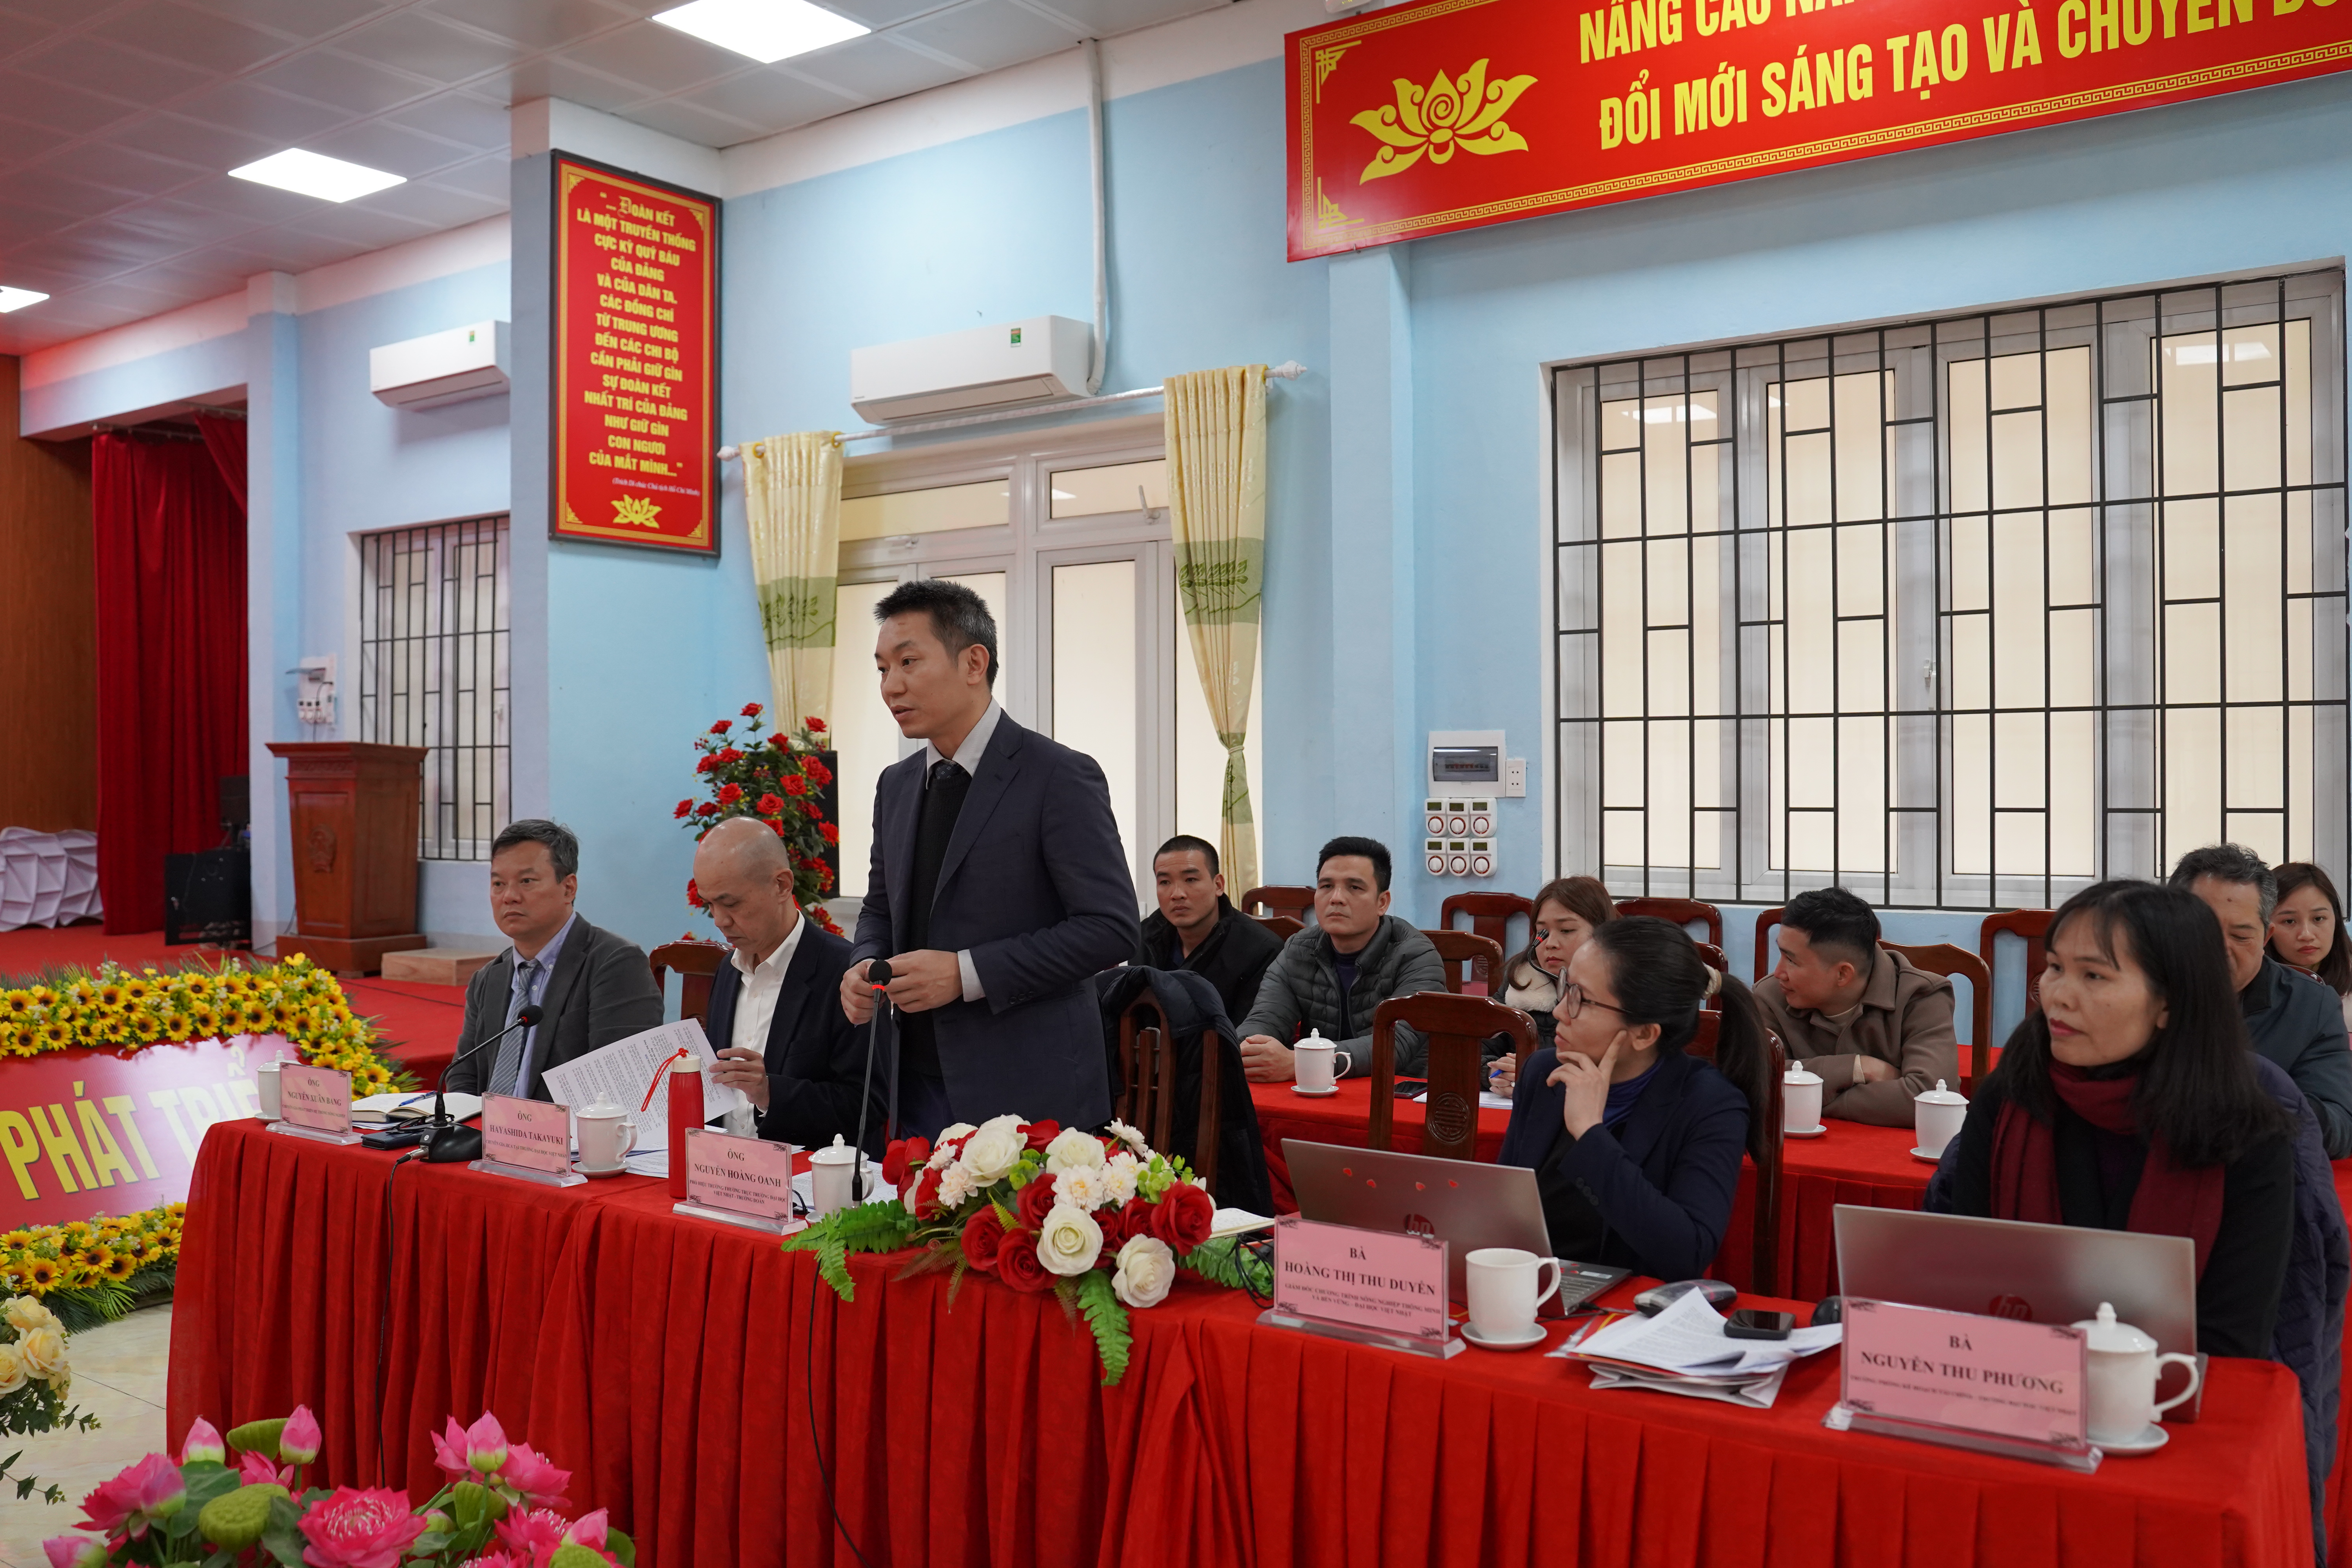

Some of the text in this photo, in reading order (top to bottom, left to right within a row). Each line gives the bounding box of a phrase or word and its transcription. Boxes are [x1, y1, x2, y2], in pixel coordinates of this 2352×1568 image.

[1599, 69, 1660, 150] ĐỔI
[1674, 61, 1747, 135] MỚI
[1762, 45, 1873, 118] SÁNG
[1887, 24, 1967, 100] TẠO
[1983, 0, 2042, 73] VÀ
[577, 208, 591, 223] LÀ
[593, 212, 617, 231] MỘT
[662, 232, 695, 251] THỐNG
[655, 211, 675, 226] KẾT
[594, 233, 617, 250] CỰC
[659, 250, 680, 266] BÁU
[610, 256, 664, 281] CỦA ĐẢNG
[597, 272, 612, 289] VÀ
[613, 276, 636, 294] CỦA
[638, 283, 660, 300] DÂN
[599, 293, 622, 310] CÁC
[656, 307, 674, 322] CHÍ
[595, 312, 678, 342] TỪ TRUNG ƯƠNG
[595, 331, 679, 364] ĐẾN CÁC CHI BỘ
[616, 356, 642, 373] PHẢI
[643, 363, 663, 377] GIỮ
[664, 366, 682, 381] GÌN
[602, 374, 671, 398] SỰ ĐOÀN KẾT
[584, 390, 687, 421] NHẤT TRÍ CỦA ĐẢNG
[604, 414, 669, 437] NHƯ GIỮ GÌN
[608, 434, 631, 450] CON
[589, 449, 612, 466] CỦA
[614, 453, 637, 470] MẮT
[308, 1077, 319, 1087] ÔNG
[288, 1091, 341, 1106] NGUYỄN XUÂN BANG
[0, 1045, 261, 1200] PHÁT TRIỂ
[517, 1110, 531, 1122] ÔNG
[490, 1125, 563, 1145] HAYASHIDA TAKAYUKI
[728, 1148, 744, 1161] ÔNG
[694, 1163, 780, 1187] NGUYỄN HOÀNG OANH
[1350, 1246, 1366, 1260] BÀ
[1285, 1261, 1329, 1278] HOÀNG
[1334, 1269, 1354, 1285] THỊ
[1359, 1274, 1385, 1287] THU
[1949, 1334, 1972, 1350] BÀ
[1861, 1351, 2063, 1394] NGUYỄN THU PHƯƠNG
